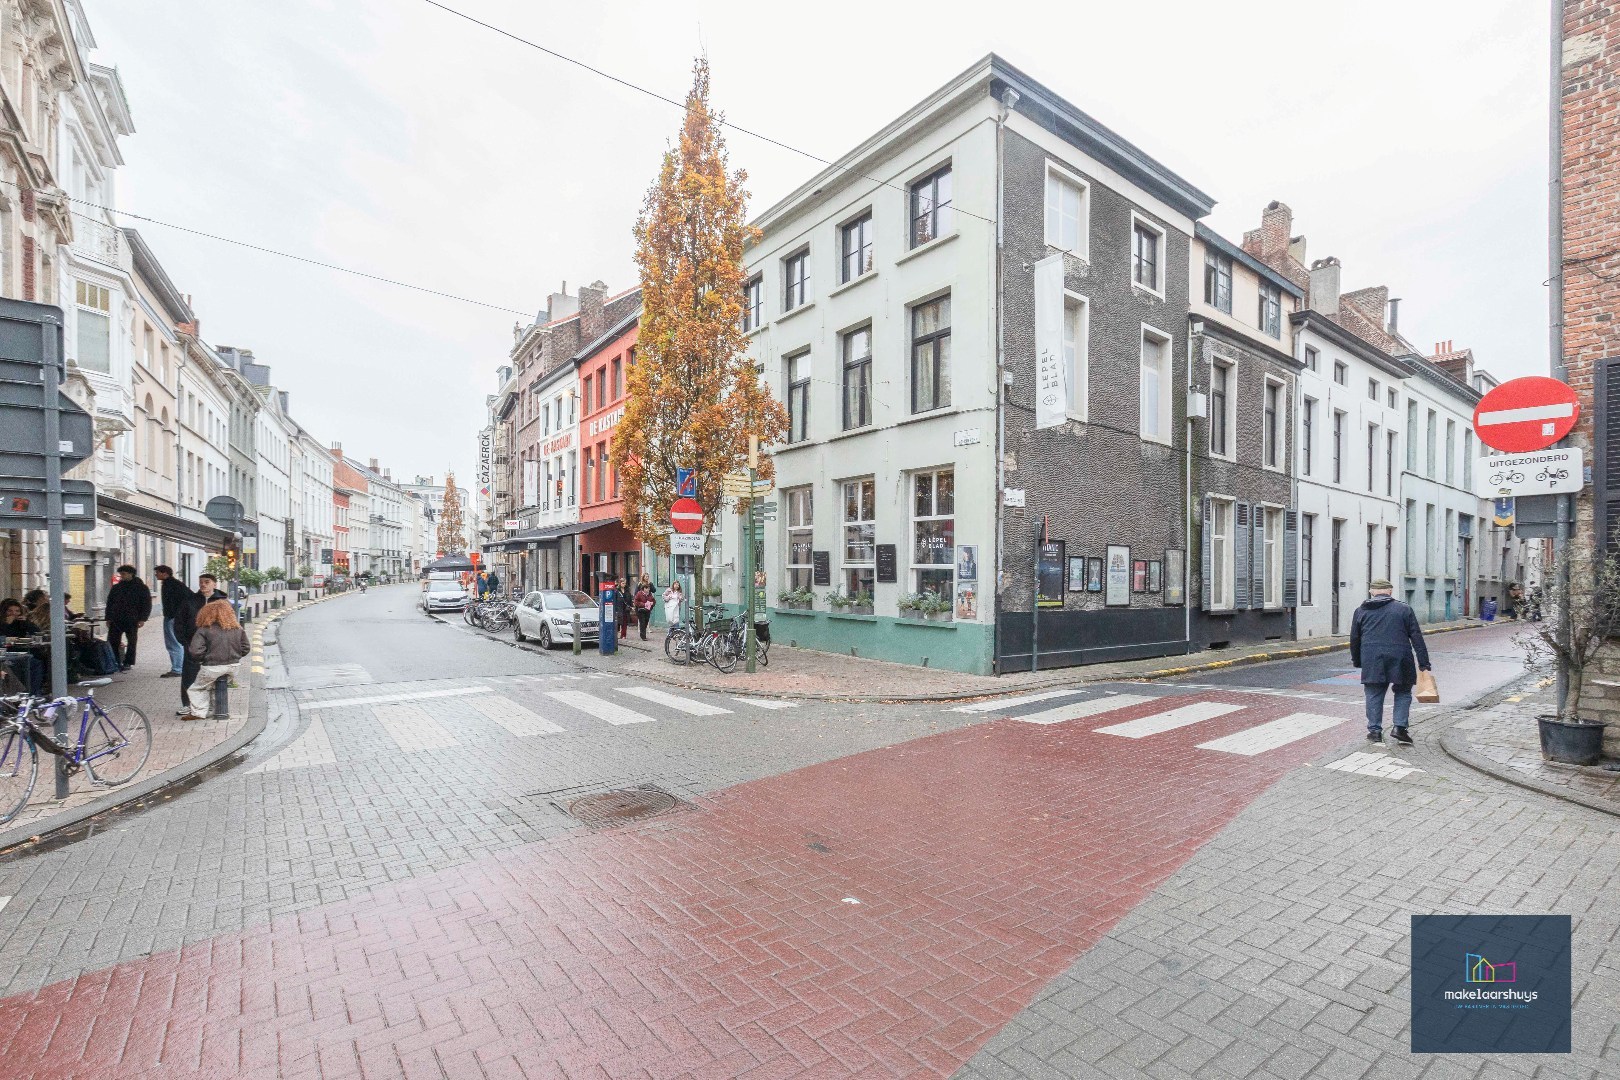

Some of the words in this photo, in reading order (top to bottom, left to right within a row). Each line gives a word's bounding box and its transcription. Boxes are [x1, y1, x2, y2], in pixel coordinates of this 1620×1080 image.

[1041, 348, 1049, 390] LEPEL
[481, 433, 490, 484] CAZAERCK
[1489, 453, 1569, 468] UITGEZONDERD
